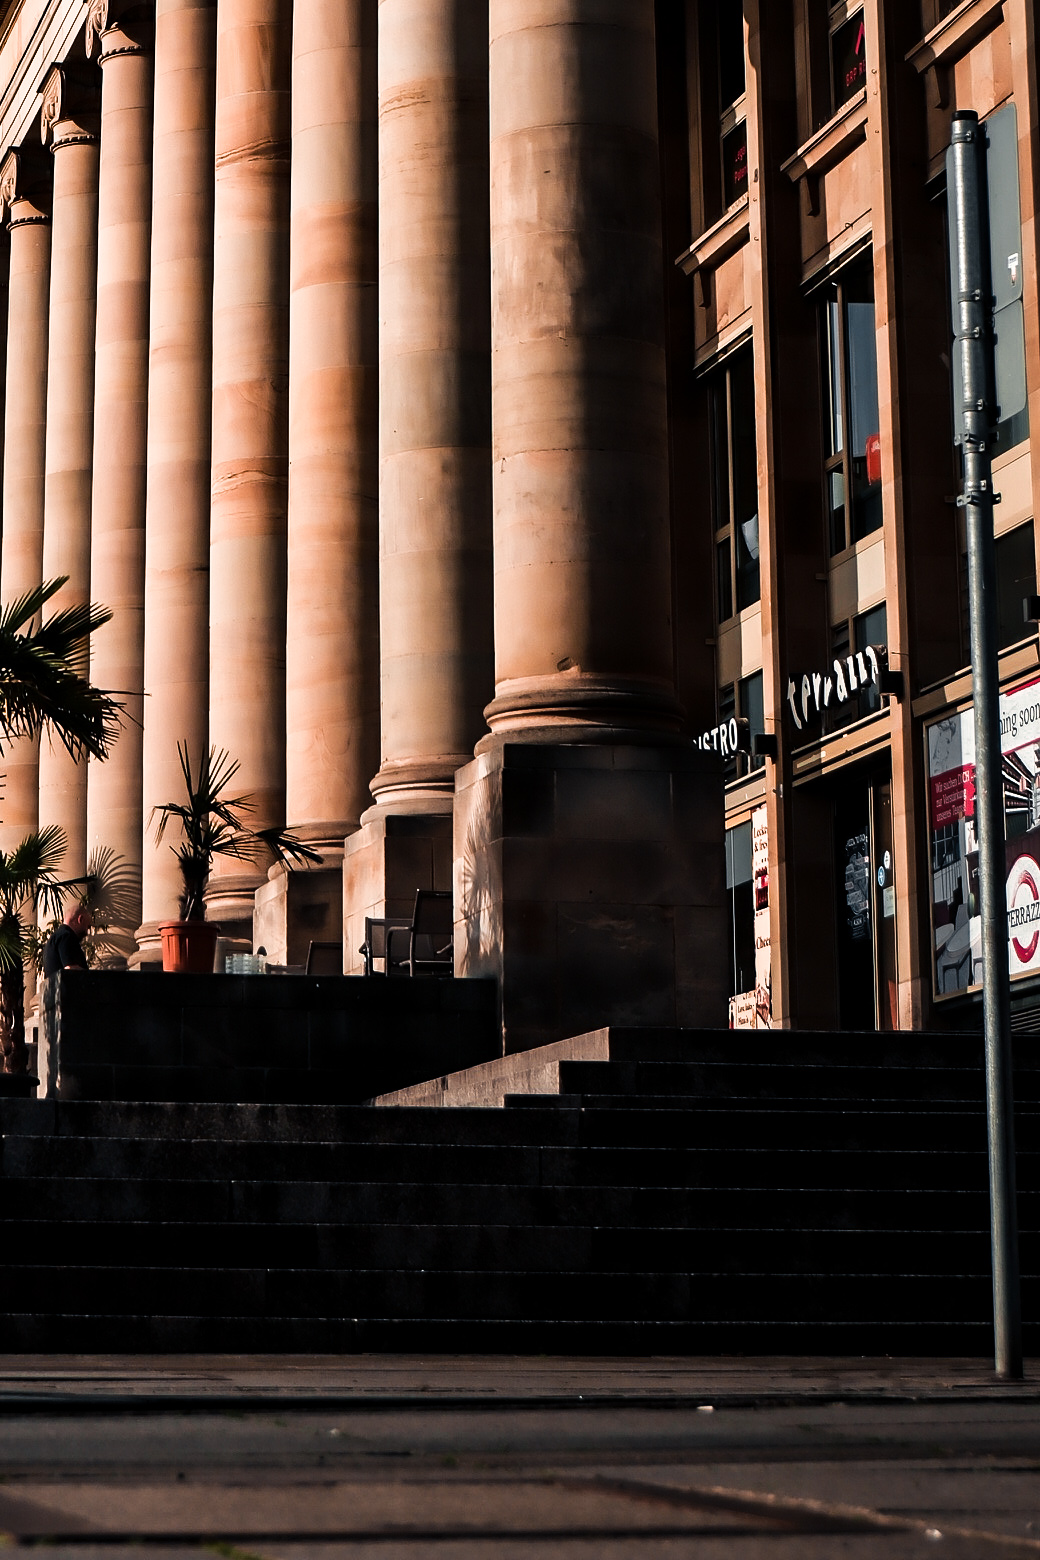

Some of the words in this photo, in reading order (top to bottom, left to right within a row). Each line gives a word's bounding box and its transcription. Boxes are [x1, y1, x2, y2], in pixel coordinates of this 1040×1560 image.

[693, 717, 738, 757] ISTRO
[999, 711, 1018, 737] ing
[1008, 901, 1040, 928] ERRAZZ
